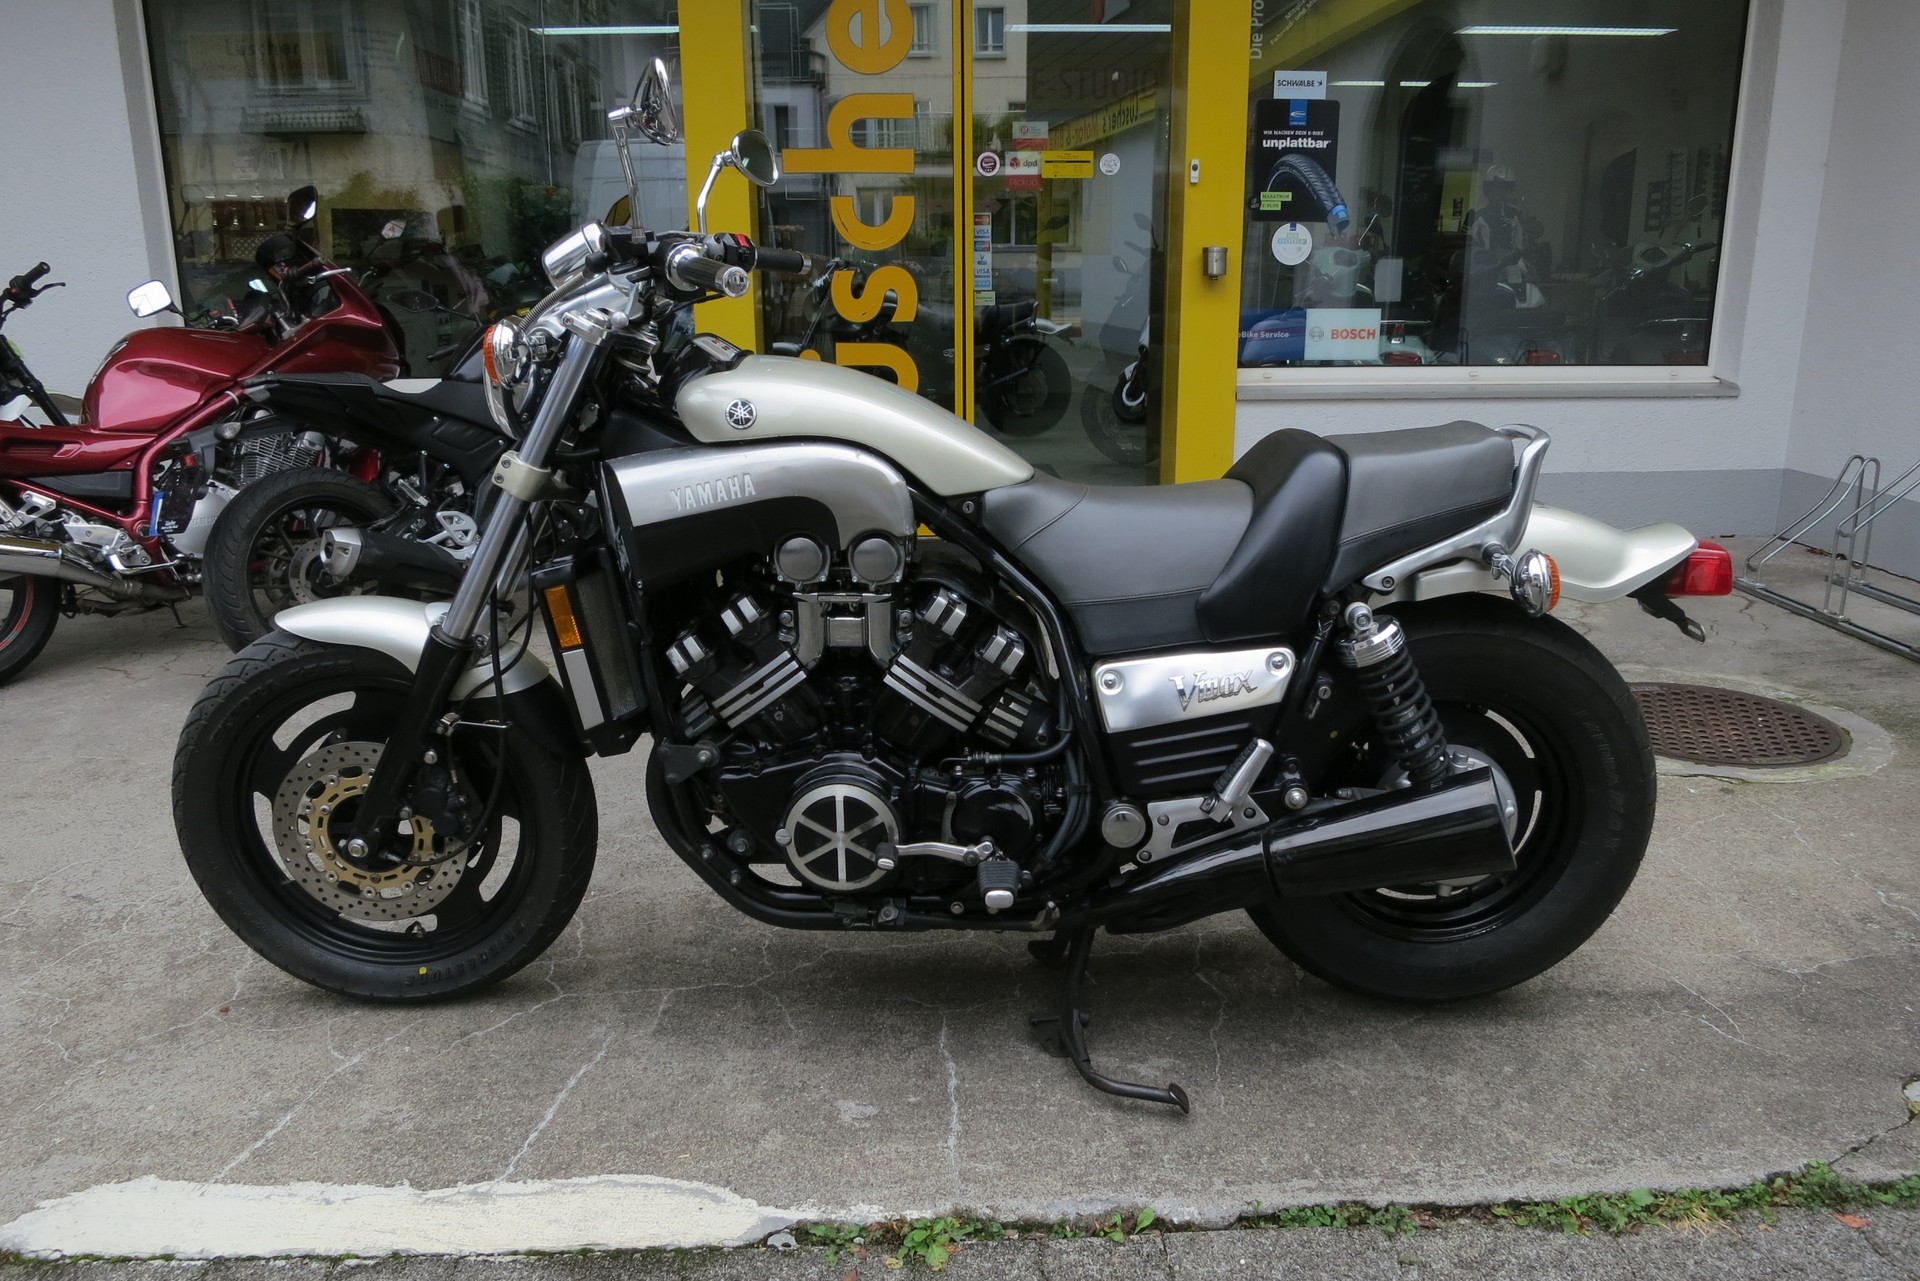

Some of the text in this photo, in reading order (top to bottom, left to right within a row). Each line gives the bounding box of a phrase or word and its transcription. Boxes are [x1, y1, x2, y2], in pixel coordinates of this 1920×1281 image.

[1249, 32, 1264, 60] Die
[1277, 79, 1316, 88] SCHWALBE
[1262, 137, 1329, 150] unplattbar
[1022, 159, 1038, 169] dpd
[1009, 178, 1038, 188] Pickup
[976, 267, 990, 275] VISA
[1260, 330, 1290, 339] Service
[1330, 328, 1376, 340] BOSCH
[671, 473, 756, 512] YAMAHA
[1168, 669, 1258, 713] Vmax
